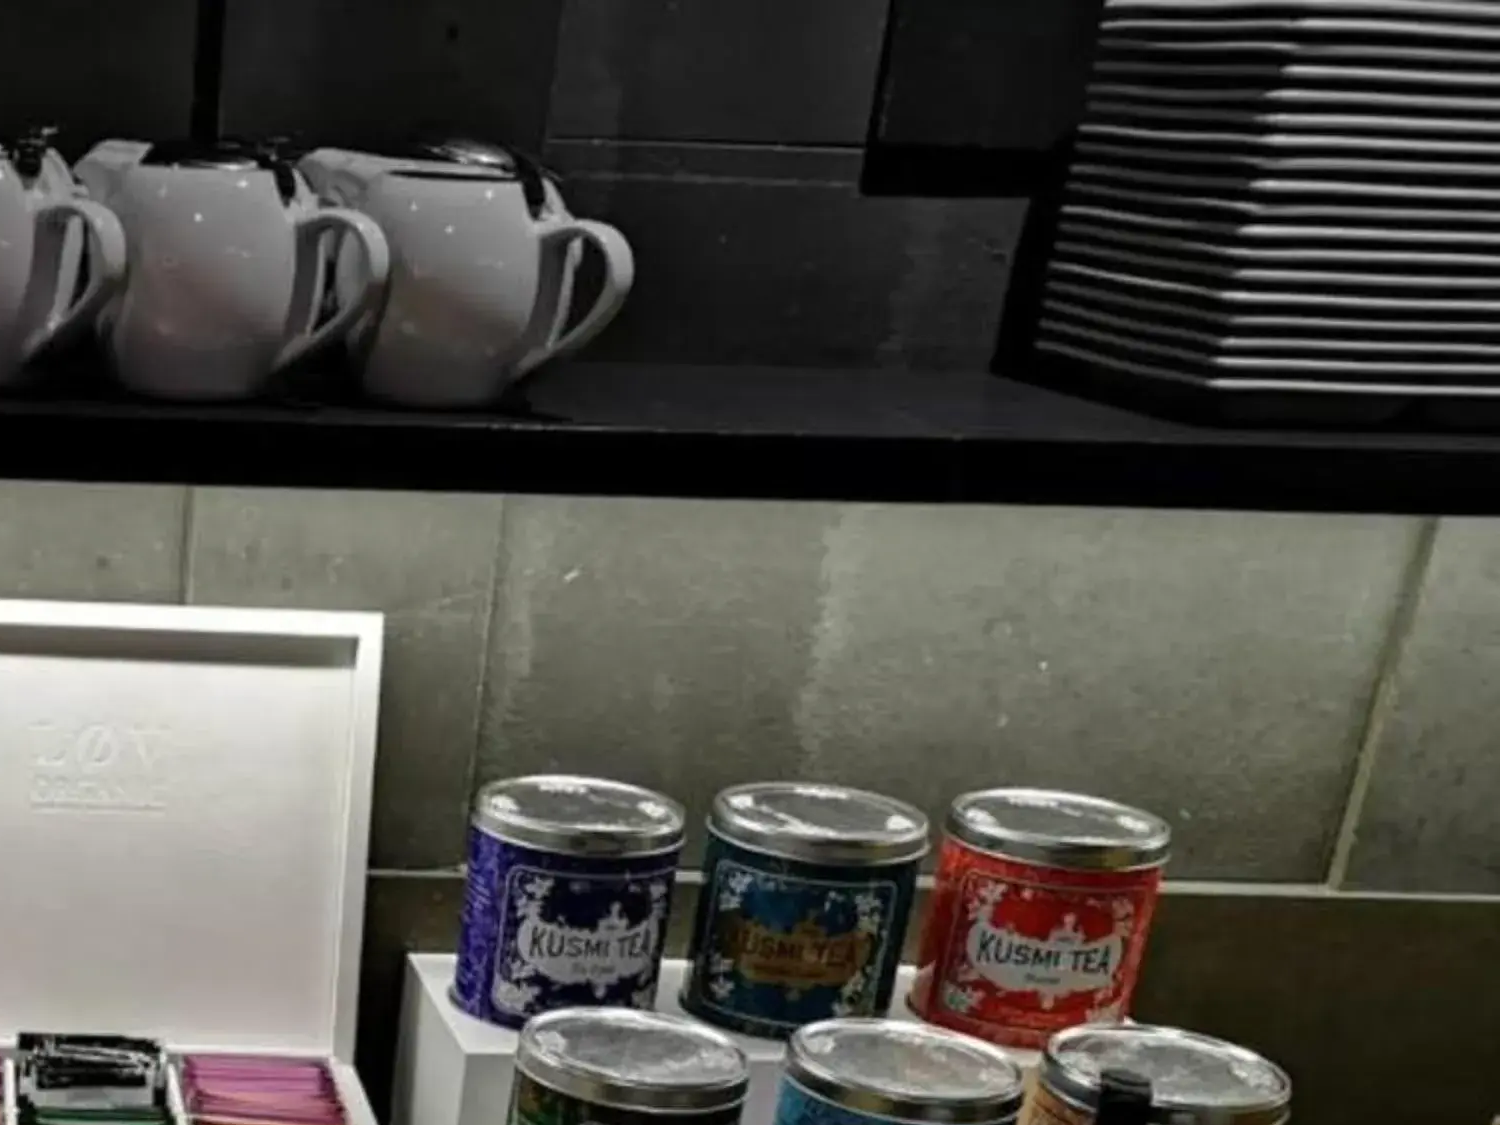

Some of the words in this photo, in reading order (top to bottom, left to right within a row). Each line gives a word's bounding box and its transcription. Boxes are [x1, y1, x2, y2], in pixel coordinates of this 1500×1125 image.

[528, 925, 611, 959] KUSMI
[975, 930, 1061, 967] KUSMI
[1071, 947, 1110, 975] TEA
